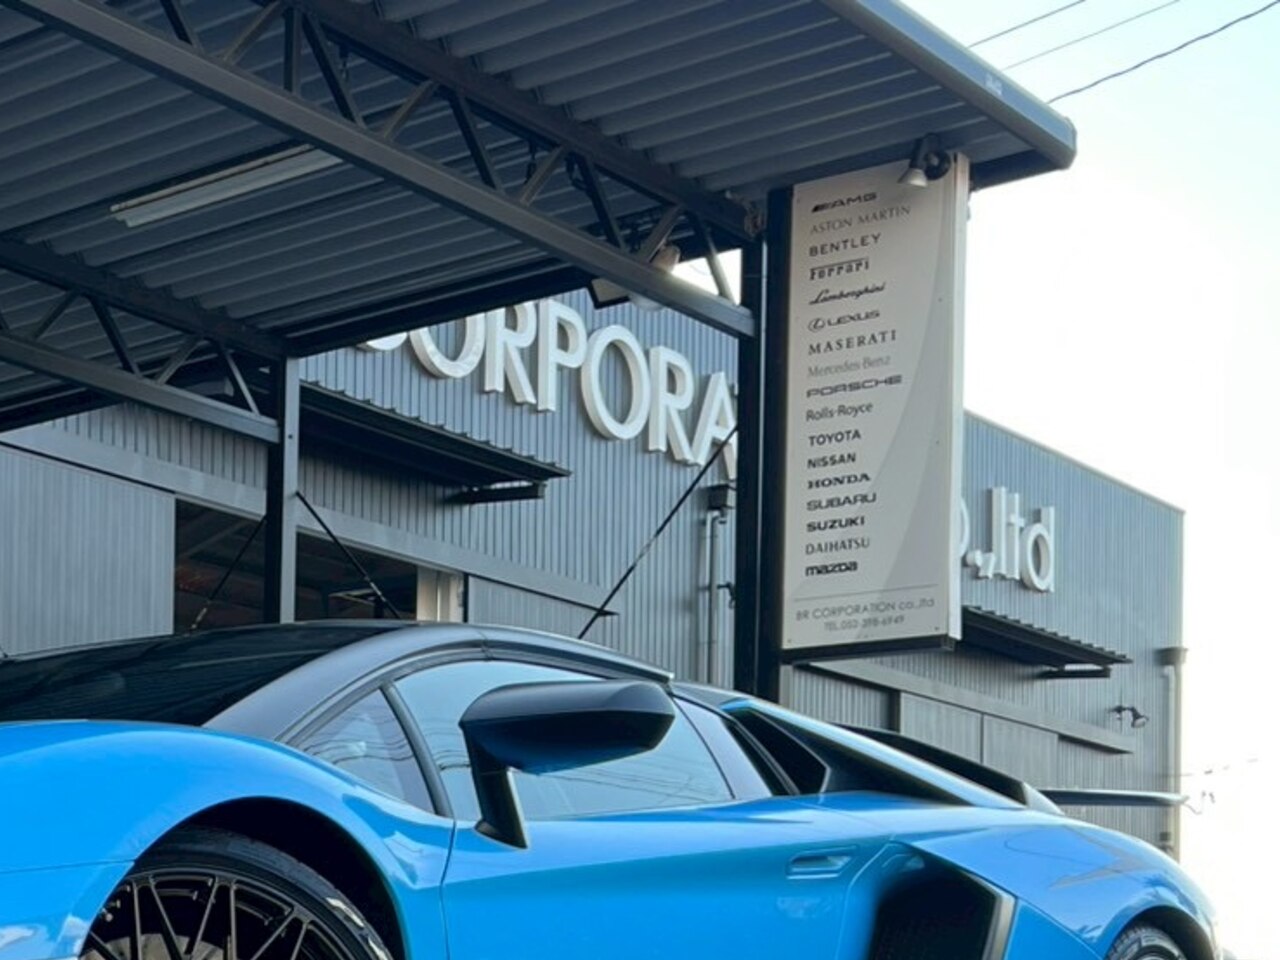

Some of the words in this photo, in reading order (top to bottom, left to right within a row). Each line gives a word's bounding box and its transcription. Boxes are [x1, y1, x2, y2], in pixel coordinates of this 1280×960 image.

[810, 217, 852, 235] ASTON
[857, 204, 911, 225] MARTIN
[809, 233, 881, 257] BENTLEY
[809, 257, 869, 280] Ferrari
[809, 282, 886, 305] Lamborghini
[826, 310, 880, 327] LEXUS
[808, 329, 896, 356] MASERATI
[806, 374, 902, 398] PORSCHE
[808, 429, 861, 447] TOYOTA
[807, 452, 856, 469] NISSAN
[808, 473, 871, 489] HONDA
[806, 492, 877, 511] SUBARU
[806, 515, 865, 533] SUZUKI
[805, 536, 870, 555] DAIHATSU
[805, 561, 858, 577] mazda
[812, 601, 896, 619] CORPORATION
